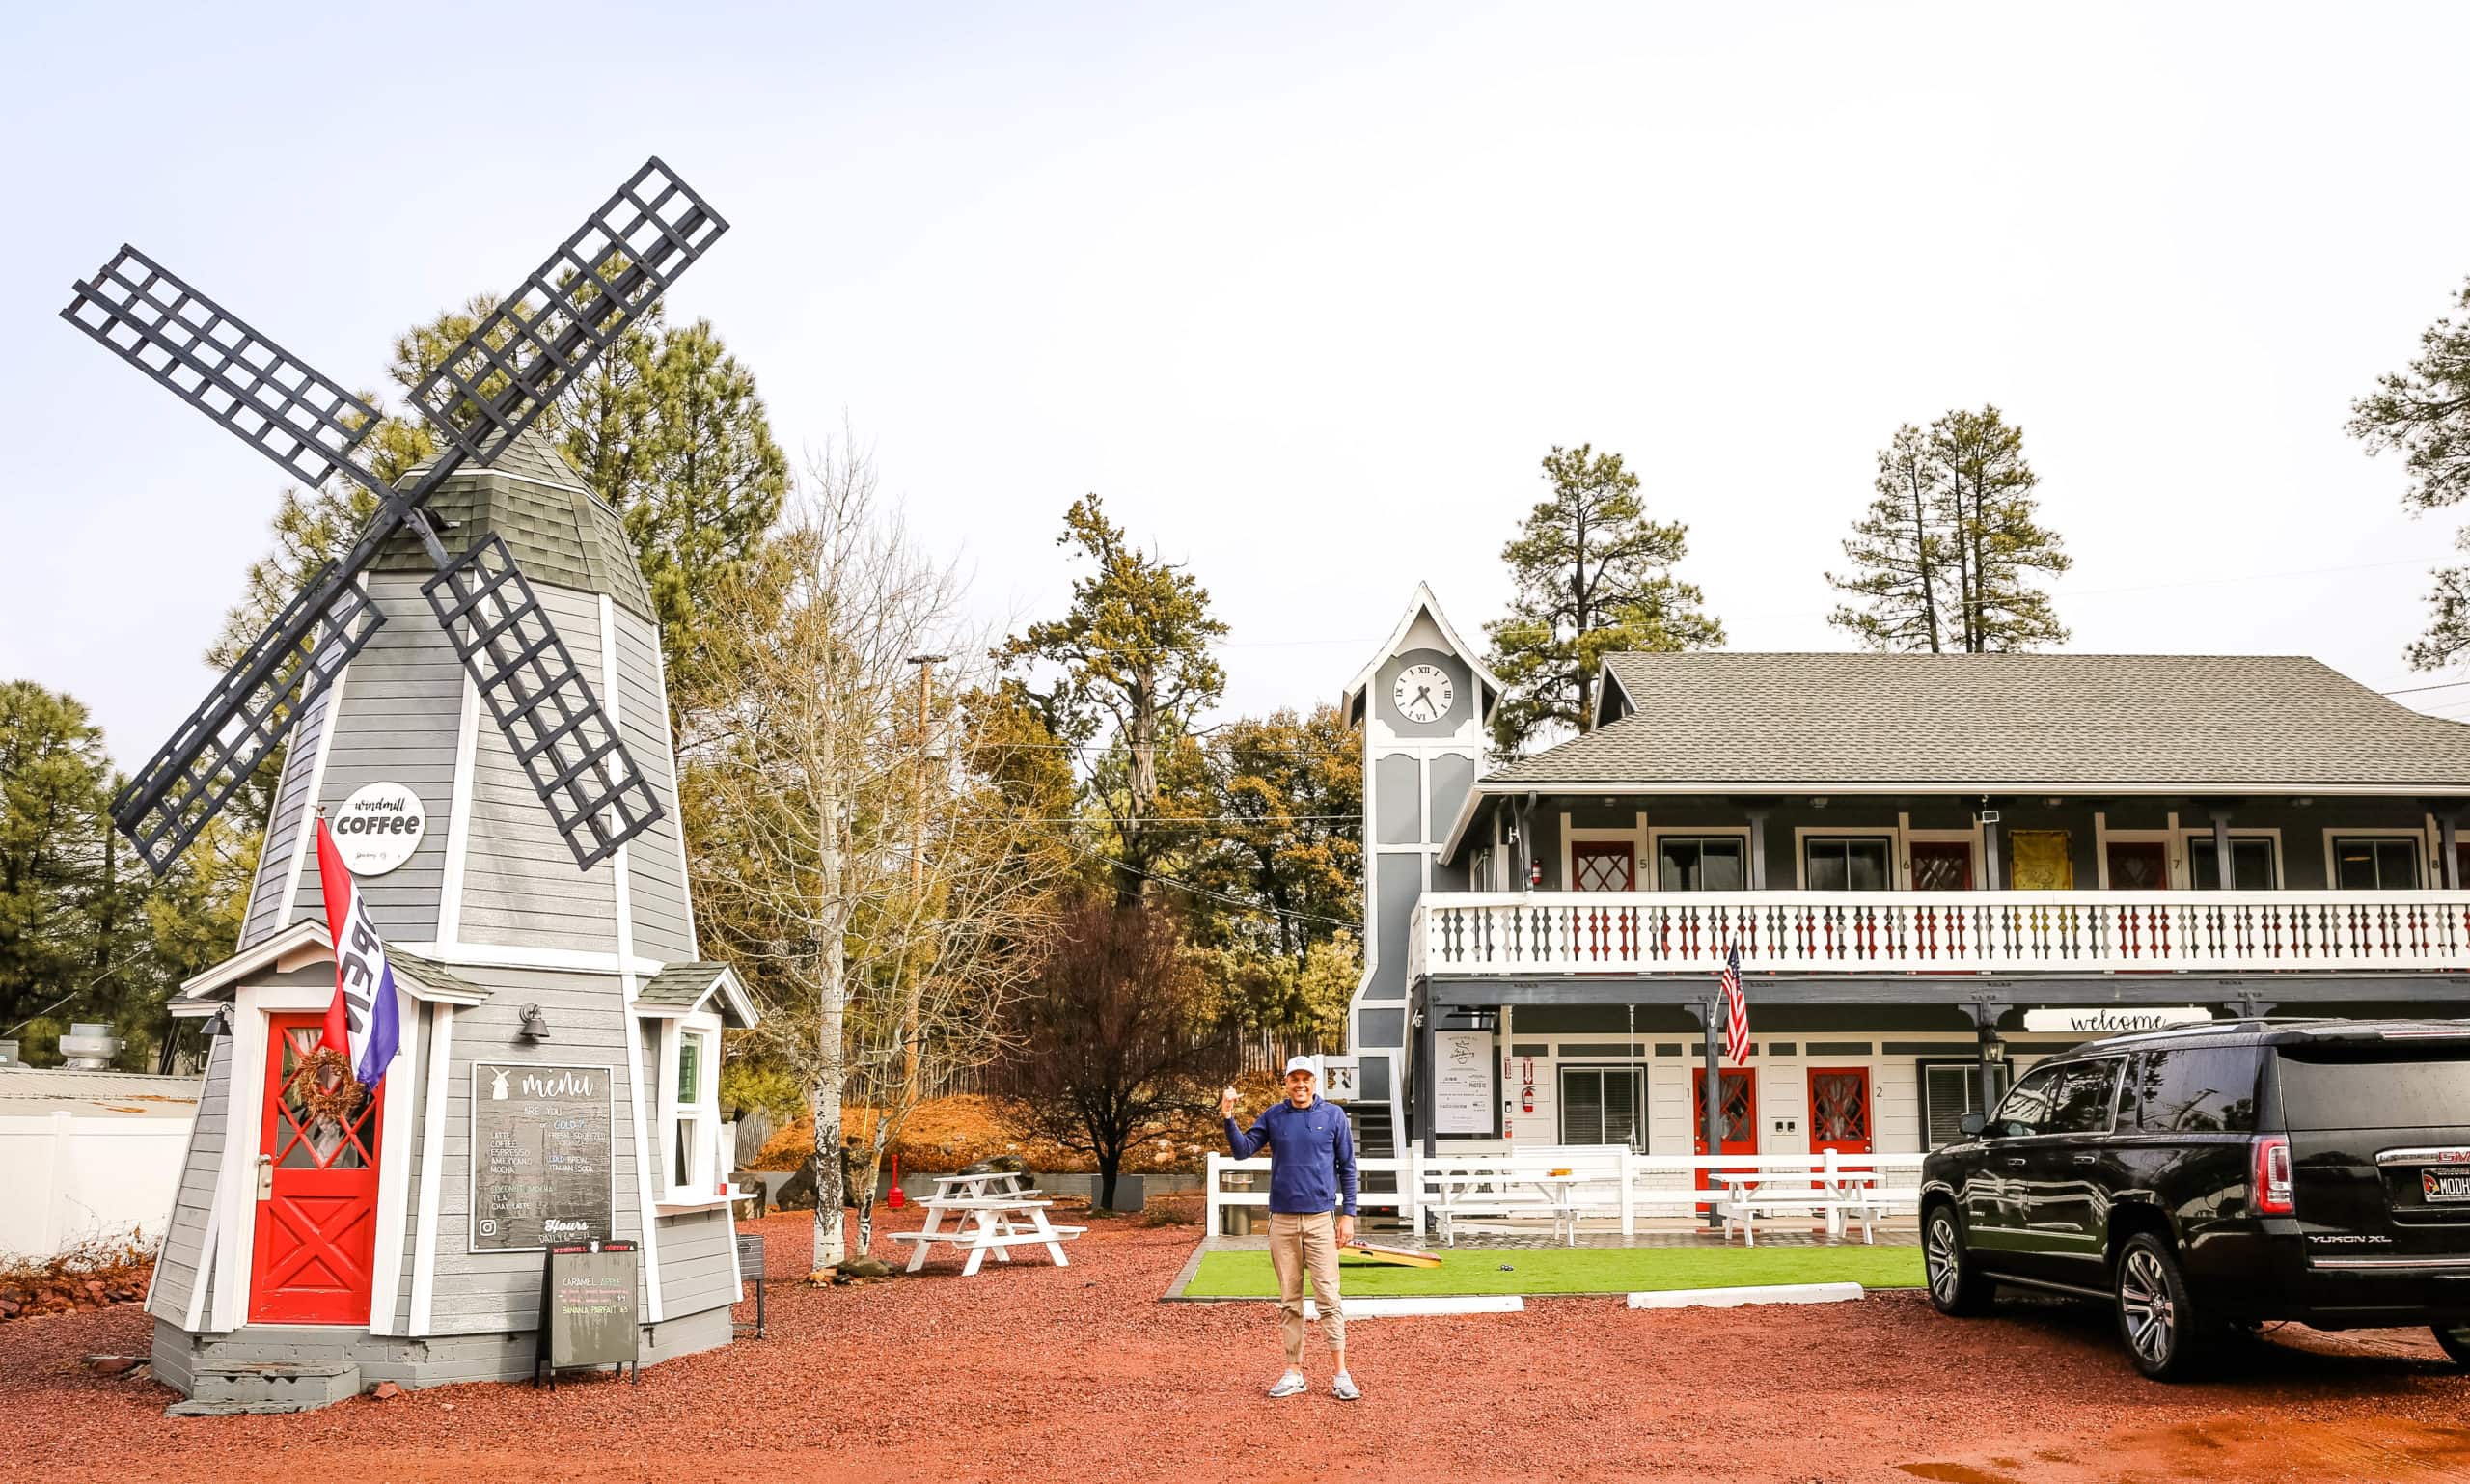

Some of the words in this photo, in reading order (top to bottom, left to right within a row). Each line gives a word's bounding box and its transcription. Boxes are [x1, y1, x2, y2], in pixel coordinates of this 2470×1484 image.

[1418, 666, 1430, 674] XII
[1443, 690, 1452, 699] III
[354, 797, 406, 812] windmill
[1639, 858, 1648, 869] 5
[1903, 860, 1910, 870] 6
[2173, 859, 2180, 869] 7
[2431, 859, 2440, 869] 8
[2071, 1009, 2167, 1031] welcome
[522, 1071, 594, 1098] menu
[1686, 1087, 1690, 1099] 1
[1875, 1086, 1883, 1098] 2
[524, 1103, 540, 1116] ARE
[546, 1104, 563, 1116] YOU
[490, 1148, 530, 1157] ESPRESSO
[490, 1165, 515, 1174] MOCHA
[2439, 1177, 2470, 1195] MODH
[544, 1218, 590, 1233] Hours
[2307, 1235, 2366, 1244] YUKON
[2368, 1235, 2393, 1244] XL
[563, 1277, 598, 1286] CARAMEL
[563, 1305, 589, 1314] BANANA
